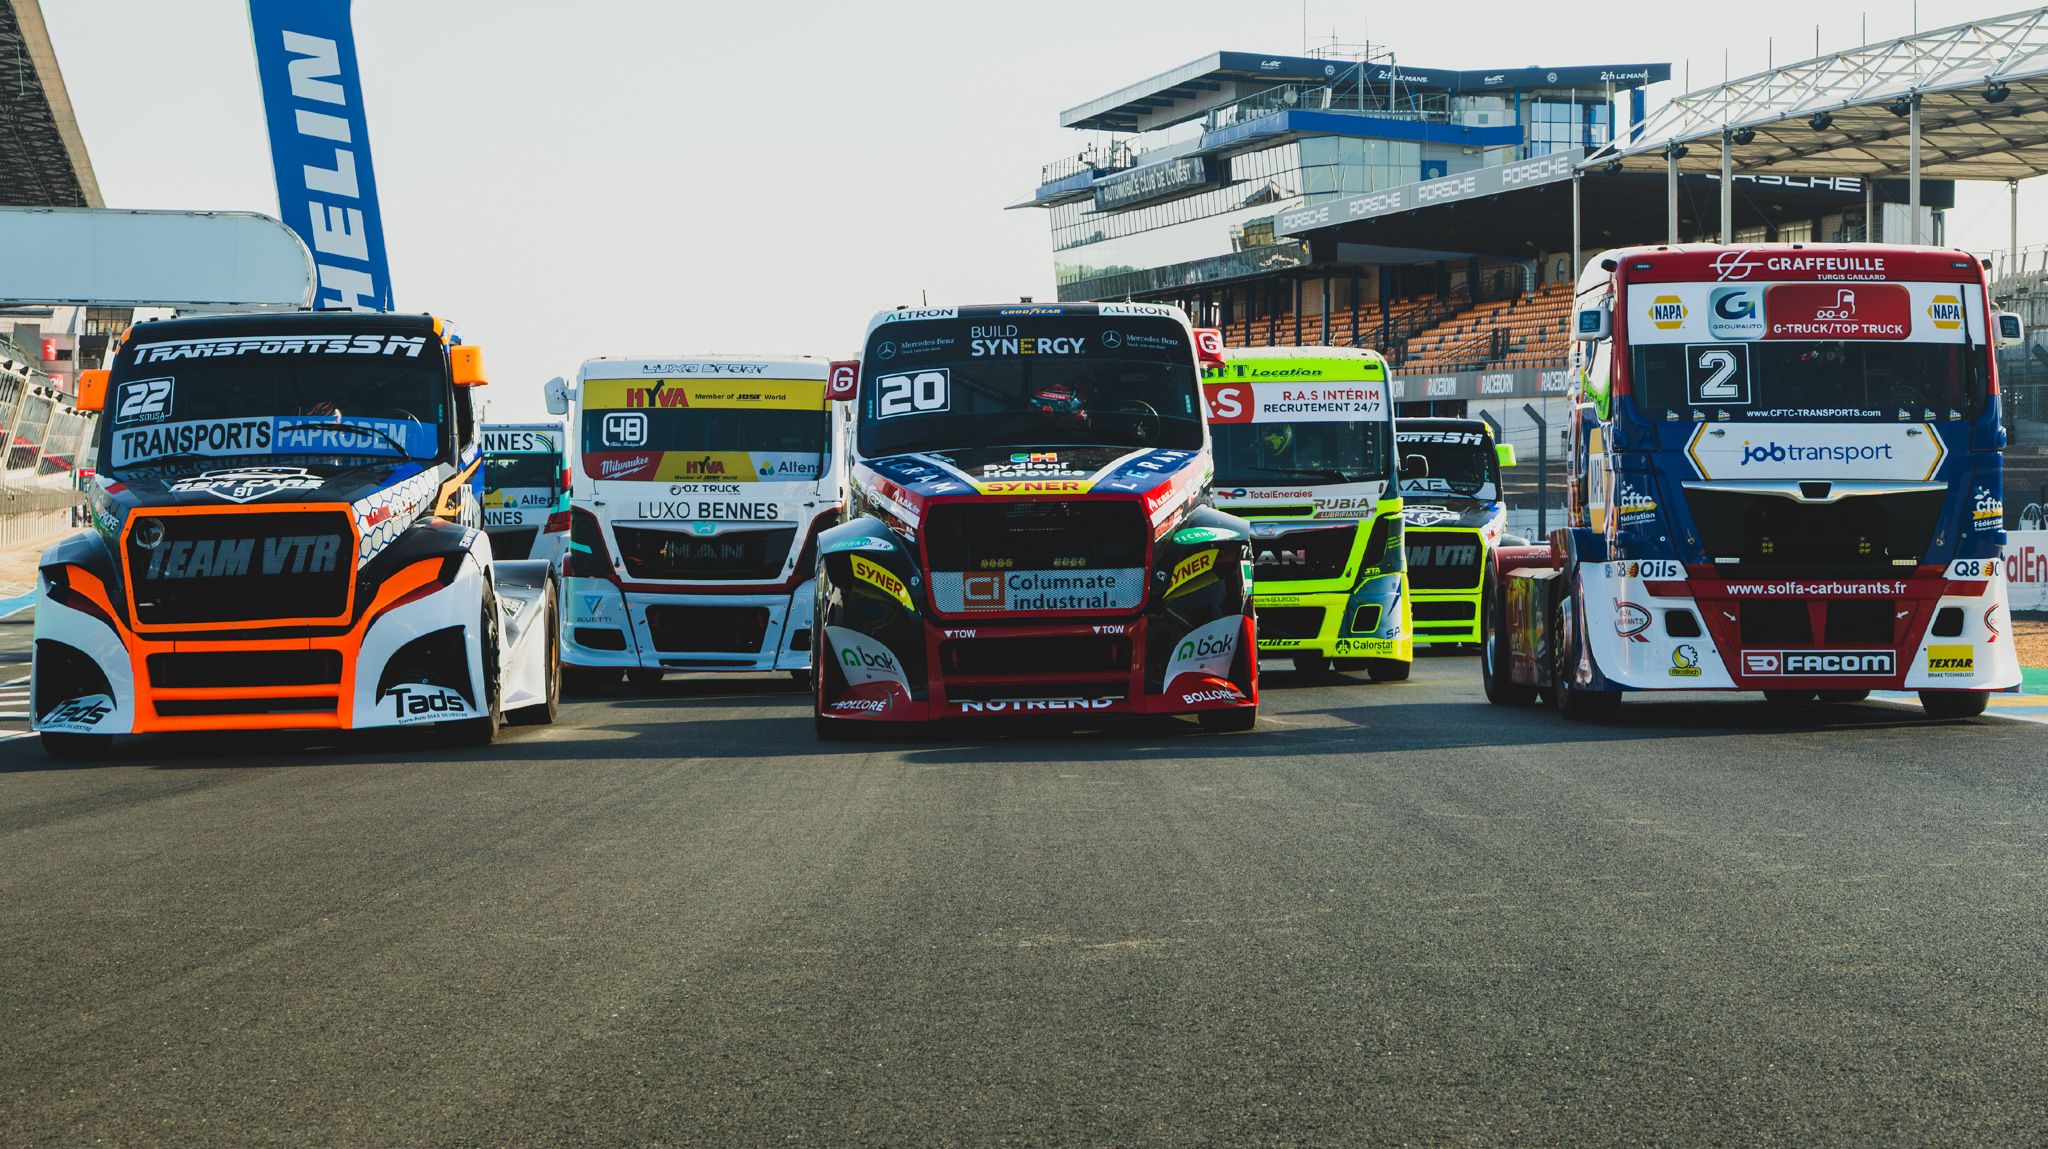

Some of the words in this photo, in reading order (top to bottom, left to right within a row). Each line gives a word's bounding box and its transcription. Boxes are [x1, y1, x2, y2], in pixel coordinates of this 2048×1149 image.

[1502, 156, 1568, 186] PORSCHE
[1104, 178, 1140, 202] AUTOMOBILE
[1140, 174, 1156, 193] CLUB
[1157, 171, 1166, 188] DE
[1418, 176, 1476, 203] PORSCHE
[1349, 191, 1401, 216] PORSCHE
[1282, 206, 1329, 230] PORSCHE
[1767, 257, 1885, 271] GRAFFEUILLE
[885, 308, 953, 323] ALTRON
[1001, 307, 1062, 316] GOODYEAR
[1103, 305, 1170, 317] ALTRON
[1655, 305, 1682, 320] NAPA
[1933, 304, 1960, 320] NAPA
[971, 325, 1017, 338] BUILD
[1773, 323, 1859, 335] G-TRUCK/TOP
[1861, 324, 1904, 335] TRUCK
[901, 336, 955, 349] Mercedes-Benz
[1126, 334, 1179, 346] Mercedes-Benz
[643, 364, 699, 374] LUXO
[701, 363, 769, 374] SPORT
[1251, 367, 1323, 377] Location
[1699, 350, 1739, 399] 2
[1427, 377, 1457, 396] RACEBORN
[1481, 373, 1514, 394] RACEBORN
[1541, 370, 1569, 392] RACEBO
[119, 380, 171, 418] 22
[626, 379, 690, 408] HYVA
[881, 373, 946, 416] 20
[1283, 391, 1319, 401] R.A.S
[1323, 387, 1379, 400] INTÉRIM
[139, 411, 165, 421] SOUSA
[1263, 403, 1350, 413] RECRUTEMENT
[1353, 402, 1380, 412] 24/7
[1746, 408, 1882, 418] www.CFTC-TRANSPORTS.com
[277, 421, 408, 451] PAPRODEM
[609, 418, 641, 441] 48
[121, 421, 272, 460] TRANSPORTS
[600, 455, 650, 475] Milwaukee
[686, 456, 726, 474] HYVA
[702, 484, 741, 493] TRUCK
[987, 482, 1080, 491] SYNER
[1249, 490, 1312, 499] TotalEnergies
[1621, 491, 1654, 509] cftc
[638, 502, 691, 518] LUXO
[698, 503, 779, 519] BENNES
[145, 538, 256, 580] TEAM
[262, 534, 343, 575] VTR
[1435, 545, 1477, 566] VTR
[1640, 560, 1677, 578] Oils
[1955, 560, 1980, 577] Q8
[856, 562, 903, 597] SYNER
[1008, 574, 1116, 590] Columnate
[1726, 582, 1907, 595] www.solfa-carburants.fr
[954, 629, 976, 638] TOW
[1102, 624, 1124, 634] TOW
[1197, 633, 1234, 656] bak
[1353, 640, 1393, 650] Calorstat
[856, 645, 897, 671] bak
[1787, 656, 1891, 671] FACOM
[1928, 658, 1973, 669] TEXTAR
[386, 688, 465, 718] Tads
[836, 699, 887, 711] BOLLORÉ
[1182, 688, 1236, 705] BOLLORÉ
[43, 700, 112, 725] Tads
